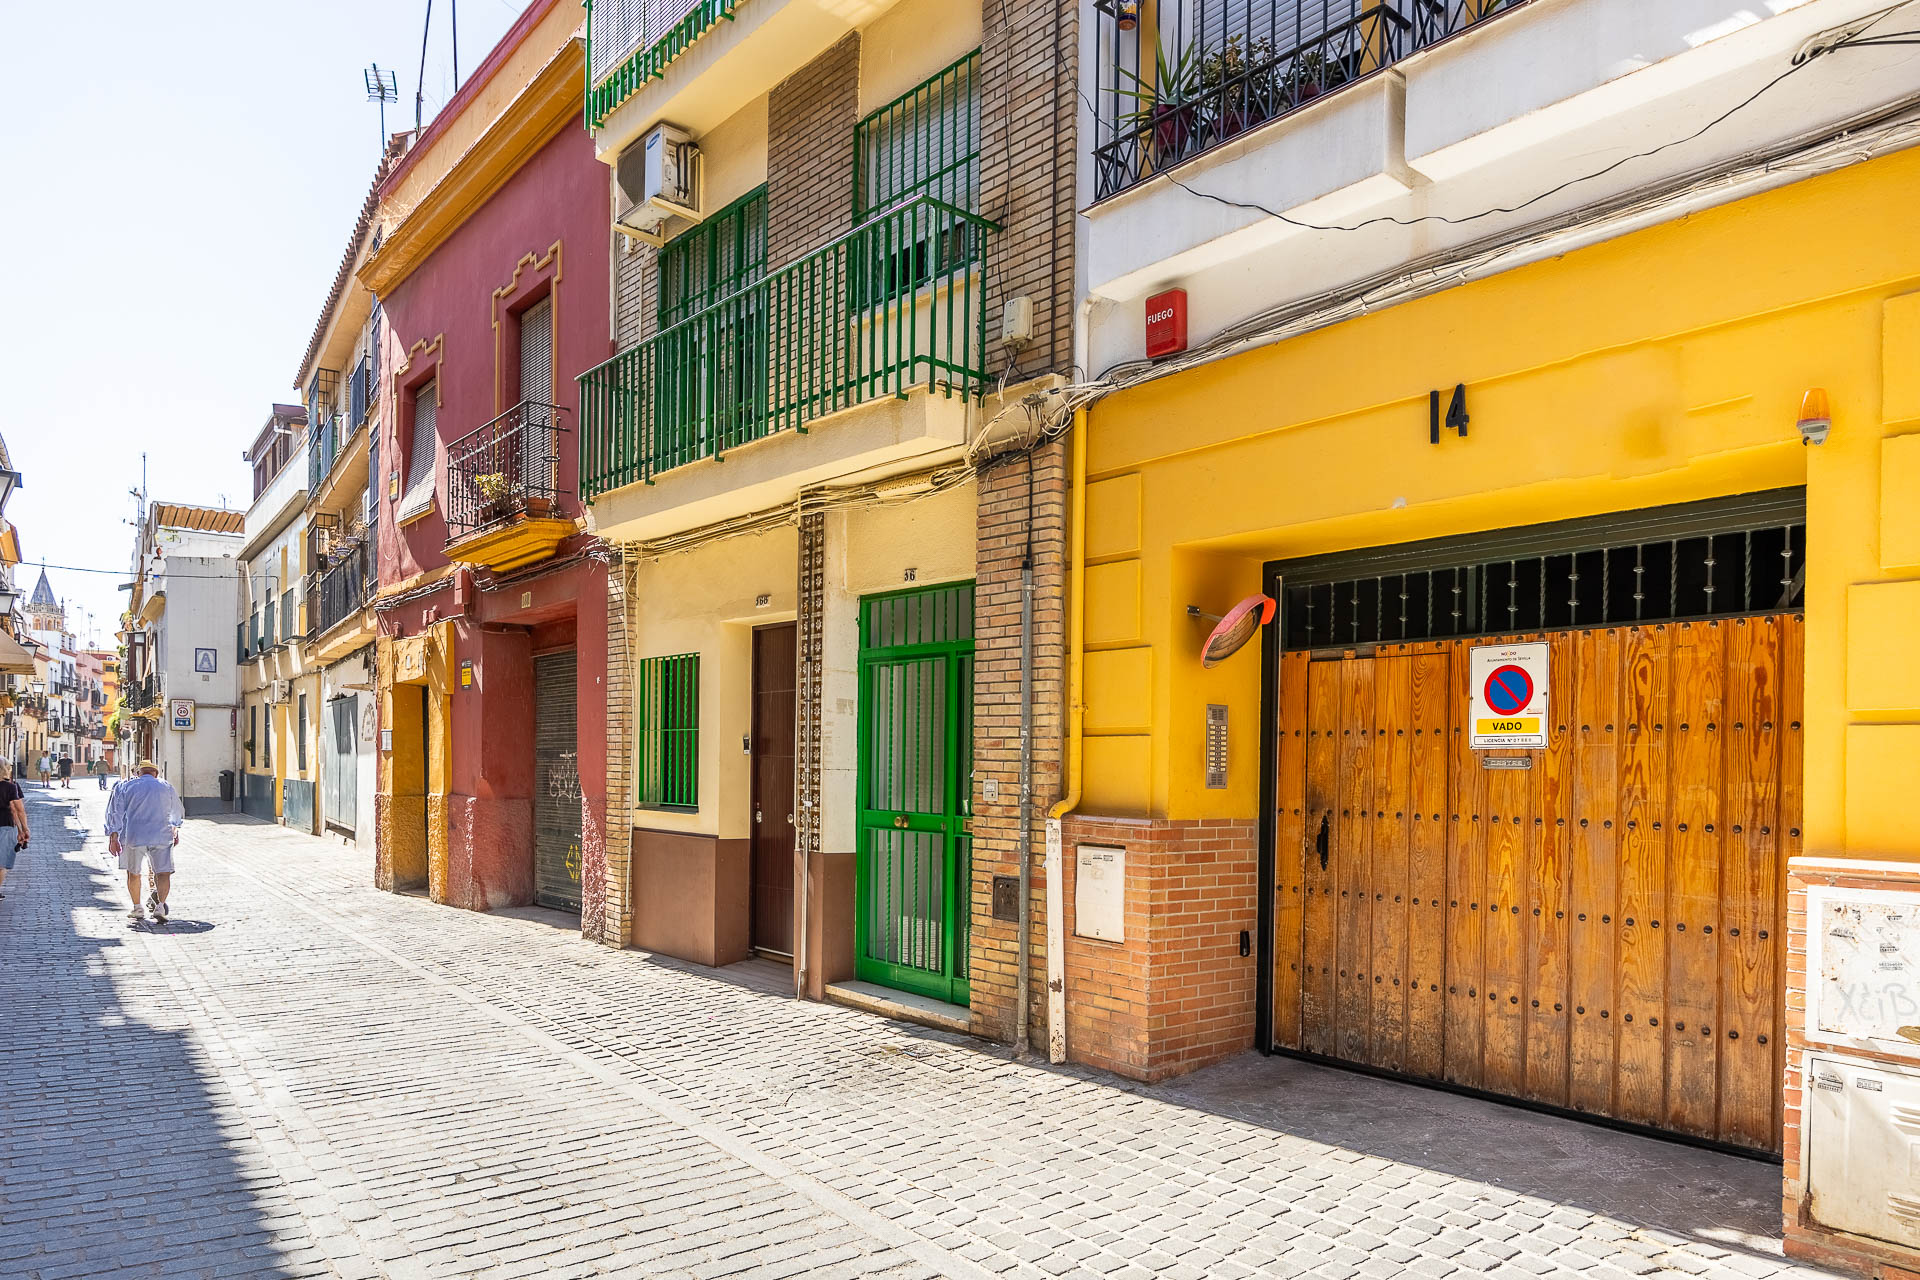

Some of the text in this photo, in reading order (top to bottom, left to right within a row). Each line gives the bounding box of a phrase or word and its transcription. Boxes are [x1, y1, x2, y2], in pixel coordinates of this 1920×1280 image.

[1147, 308, 1174, 326] FUEGO
[1430, 384, 1470, 445] 14
[1492, 721, 1523, 731] VADO
